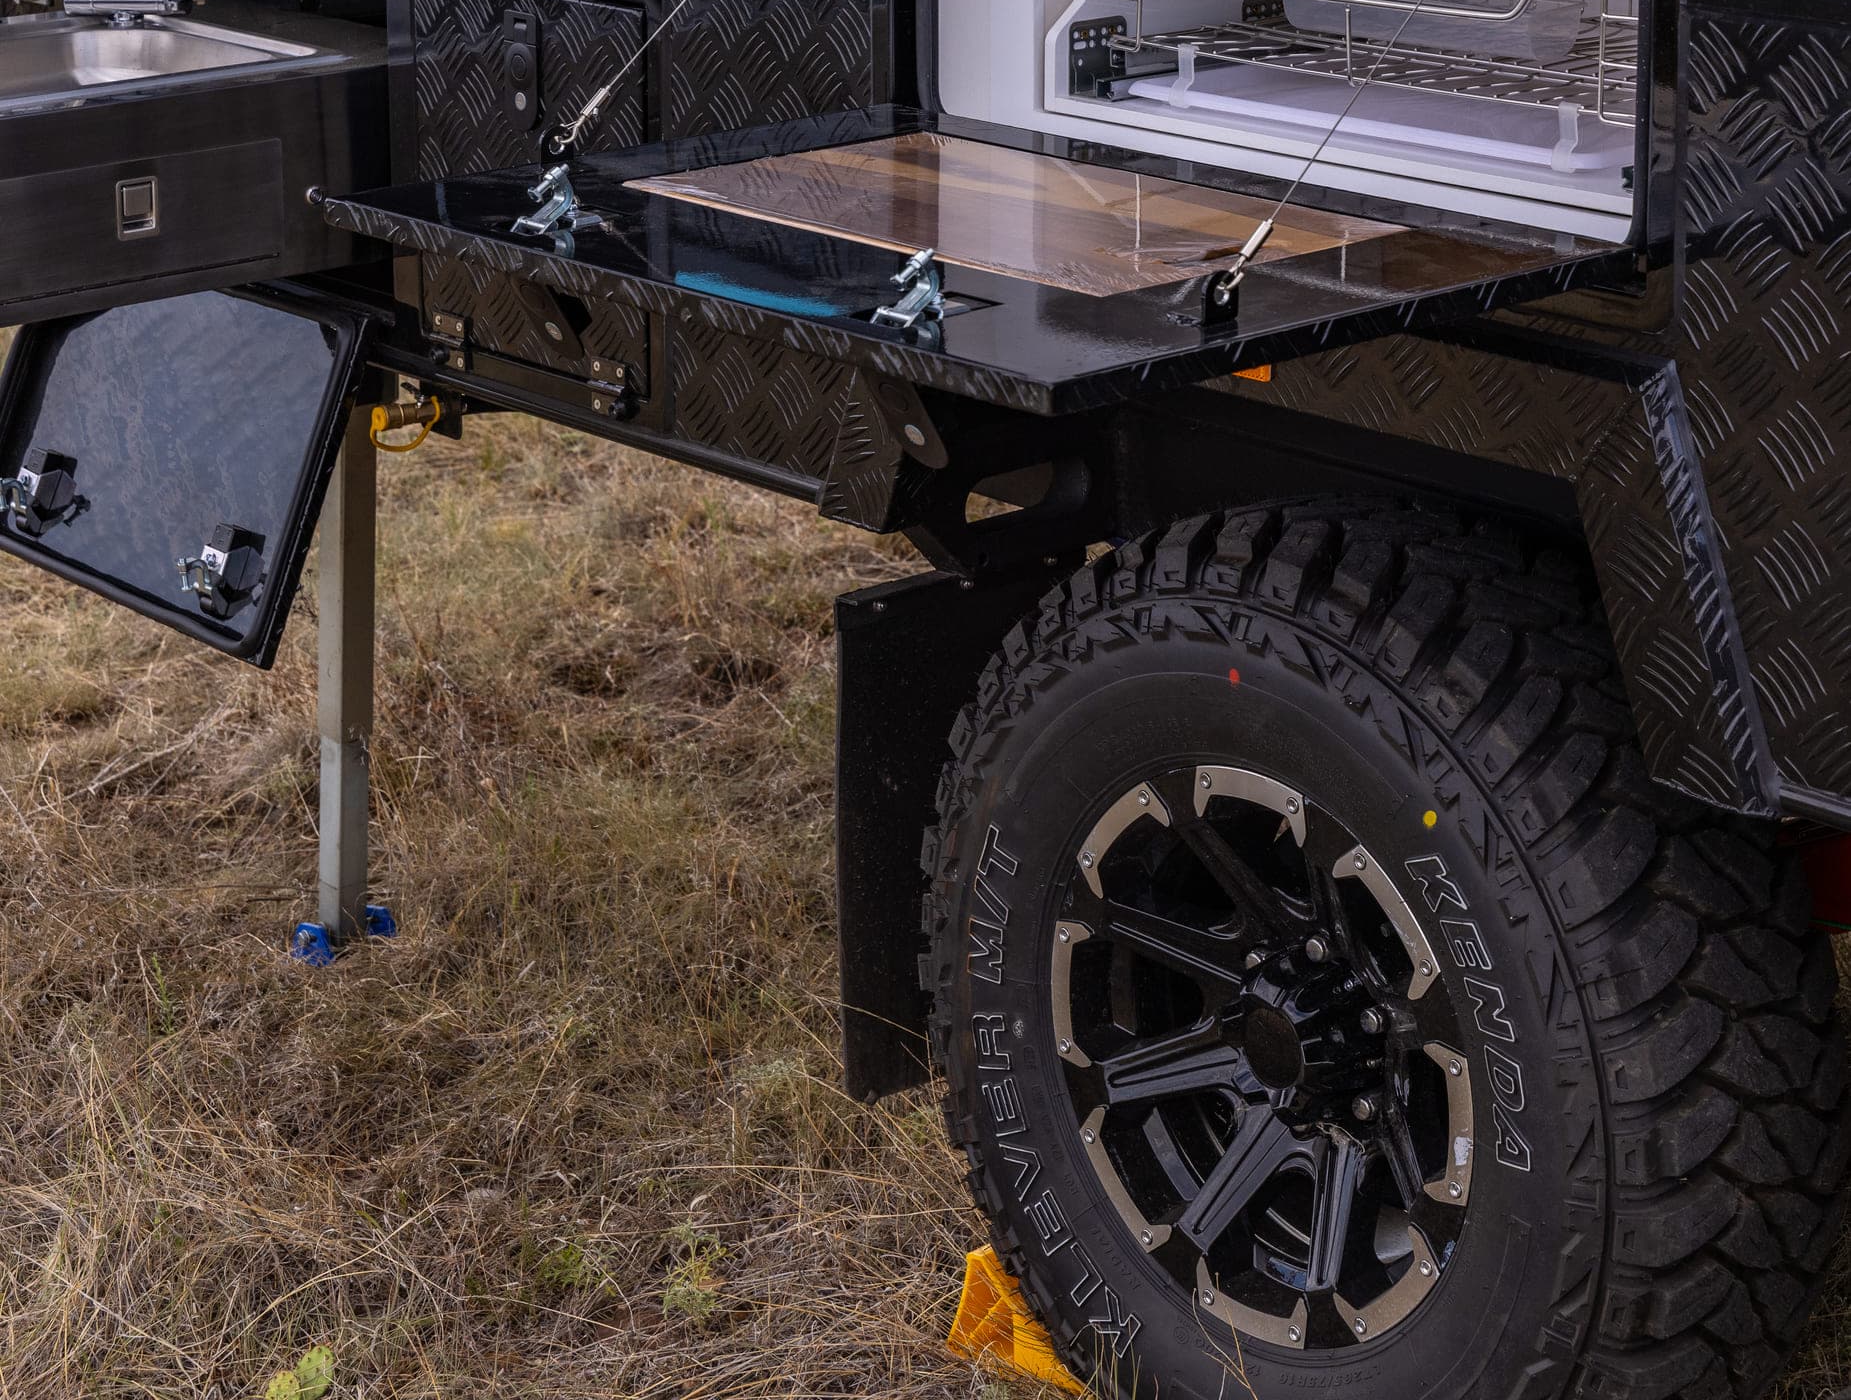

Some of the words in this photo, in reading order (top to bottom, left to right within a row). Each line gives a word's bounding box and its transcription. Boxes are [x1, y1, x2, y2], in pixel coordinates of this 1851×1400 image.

[966, 823, 1018, 984] M/T
[1404, 855, 1531, 1172] KENDA
[972, 1012, 1142, 1359] KLEVER
